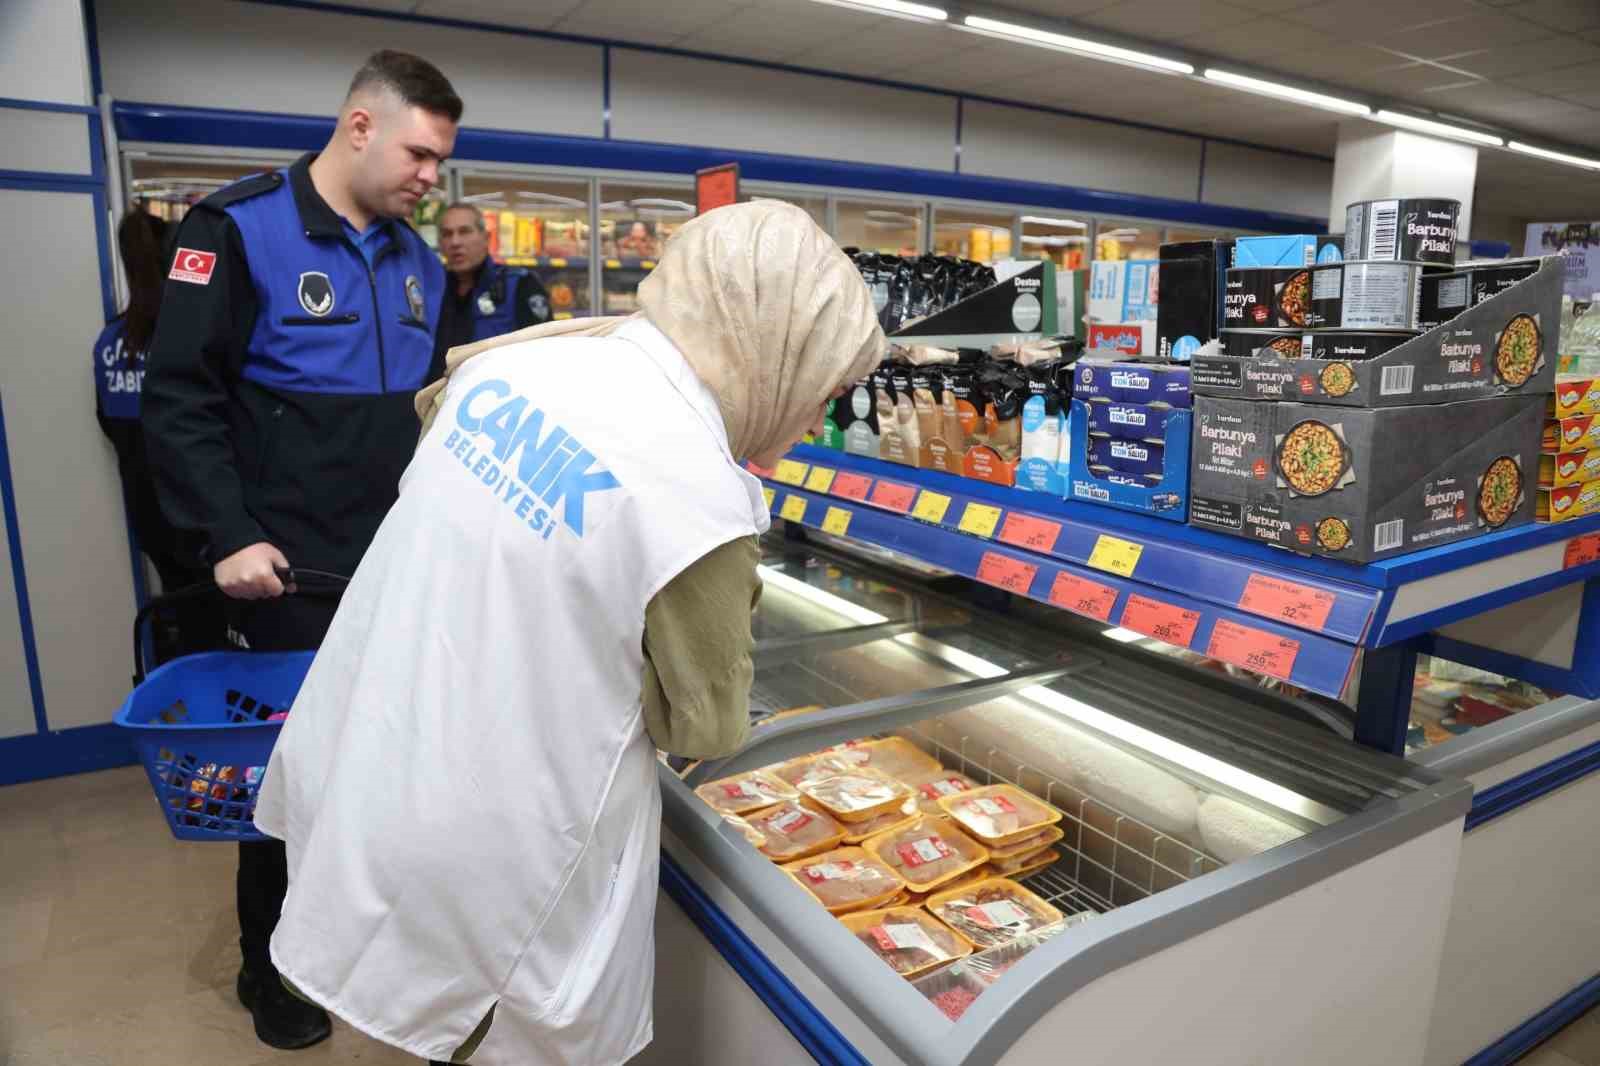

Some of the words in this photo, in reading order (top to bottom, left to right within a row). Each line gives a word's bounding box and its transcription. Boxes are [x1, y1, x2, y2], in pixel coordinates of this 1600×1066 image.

[1201, 424, 1256, 445] Barbunya
[456, 379, 623, 538] CANİK
[1212, 442, 1243, 457] Pilaki
[443, 429, 556, 540] BELEDİYESİ
[1246, 512, 1291, 531] Barbunya
